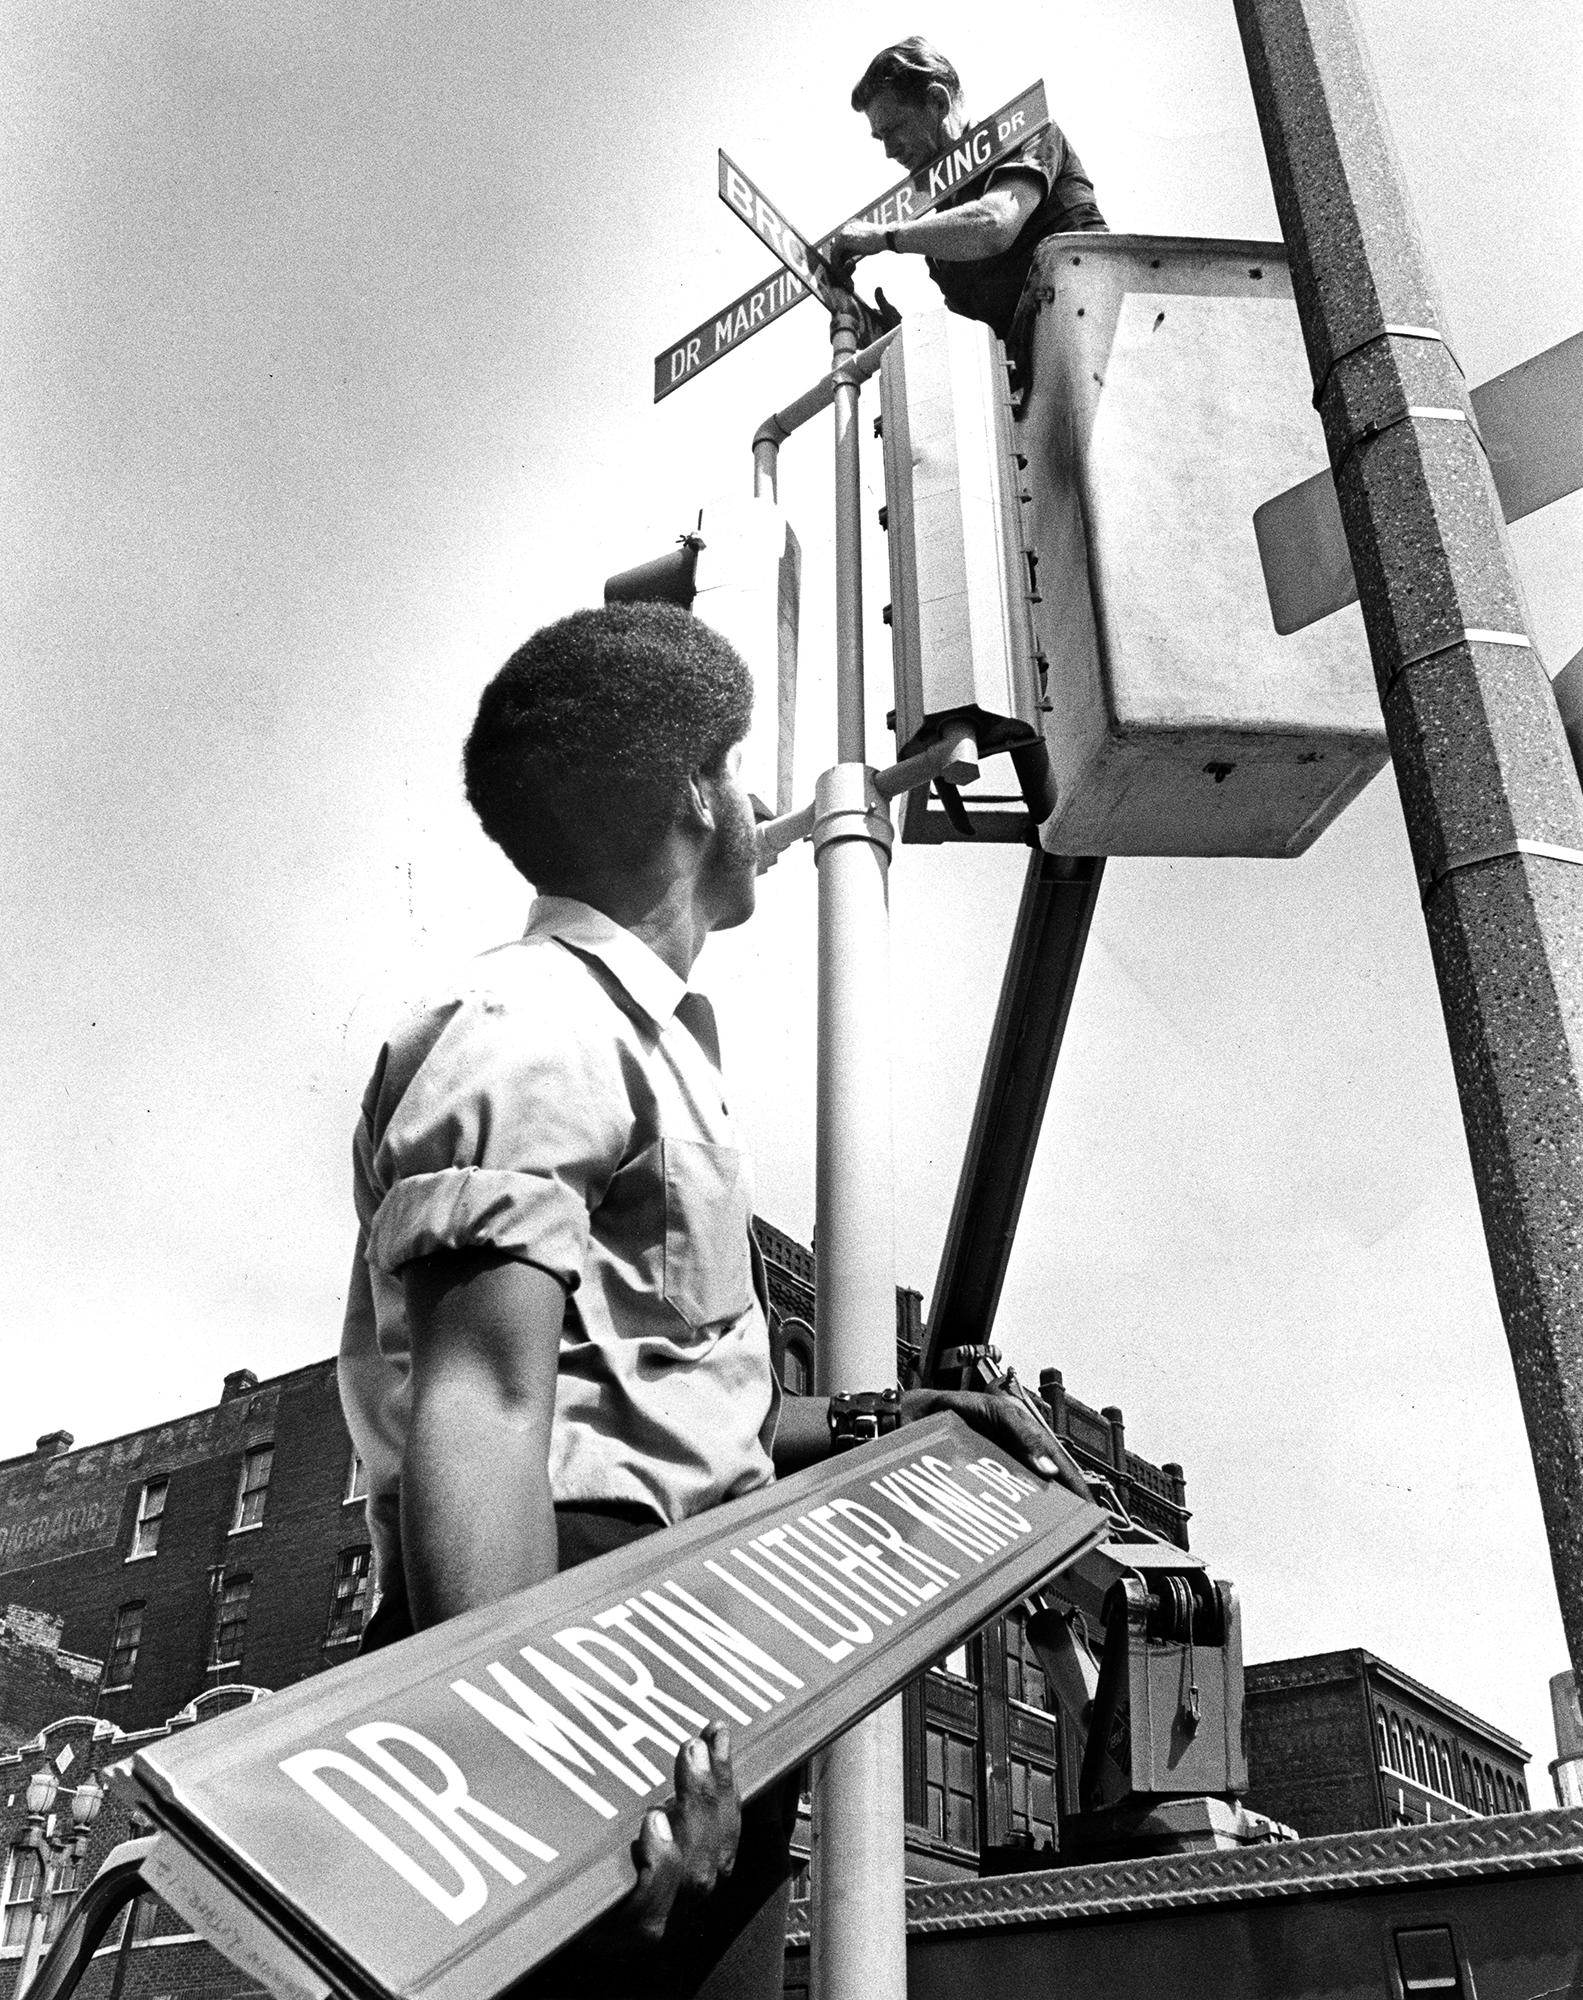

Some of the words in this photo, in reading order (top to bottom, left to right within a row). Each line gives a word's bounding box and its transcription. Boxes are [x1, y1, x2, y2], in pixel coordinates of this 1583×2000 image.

[670, 337, 702, 382] DR
[715, 270, 803, 352] MARTIN
[928, 129, 992, 200] KING
[997, 110, 1026, 142] DR
[278, 1748, 560, 1926] DR
[449, 1579, 805, 1821] MARTIN
[703, 1498, 962, 1664] LUTHER
[869, 1454, 1033, 1564] KING
[965, 1456, 1039, 1504] DR
